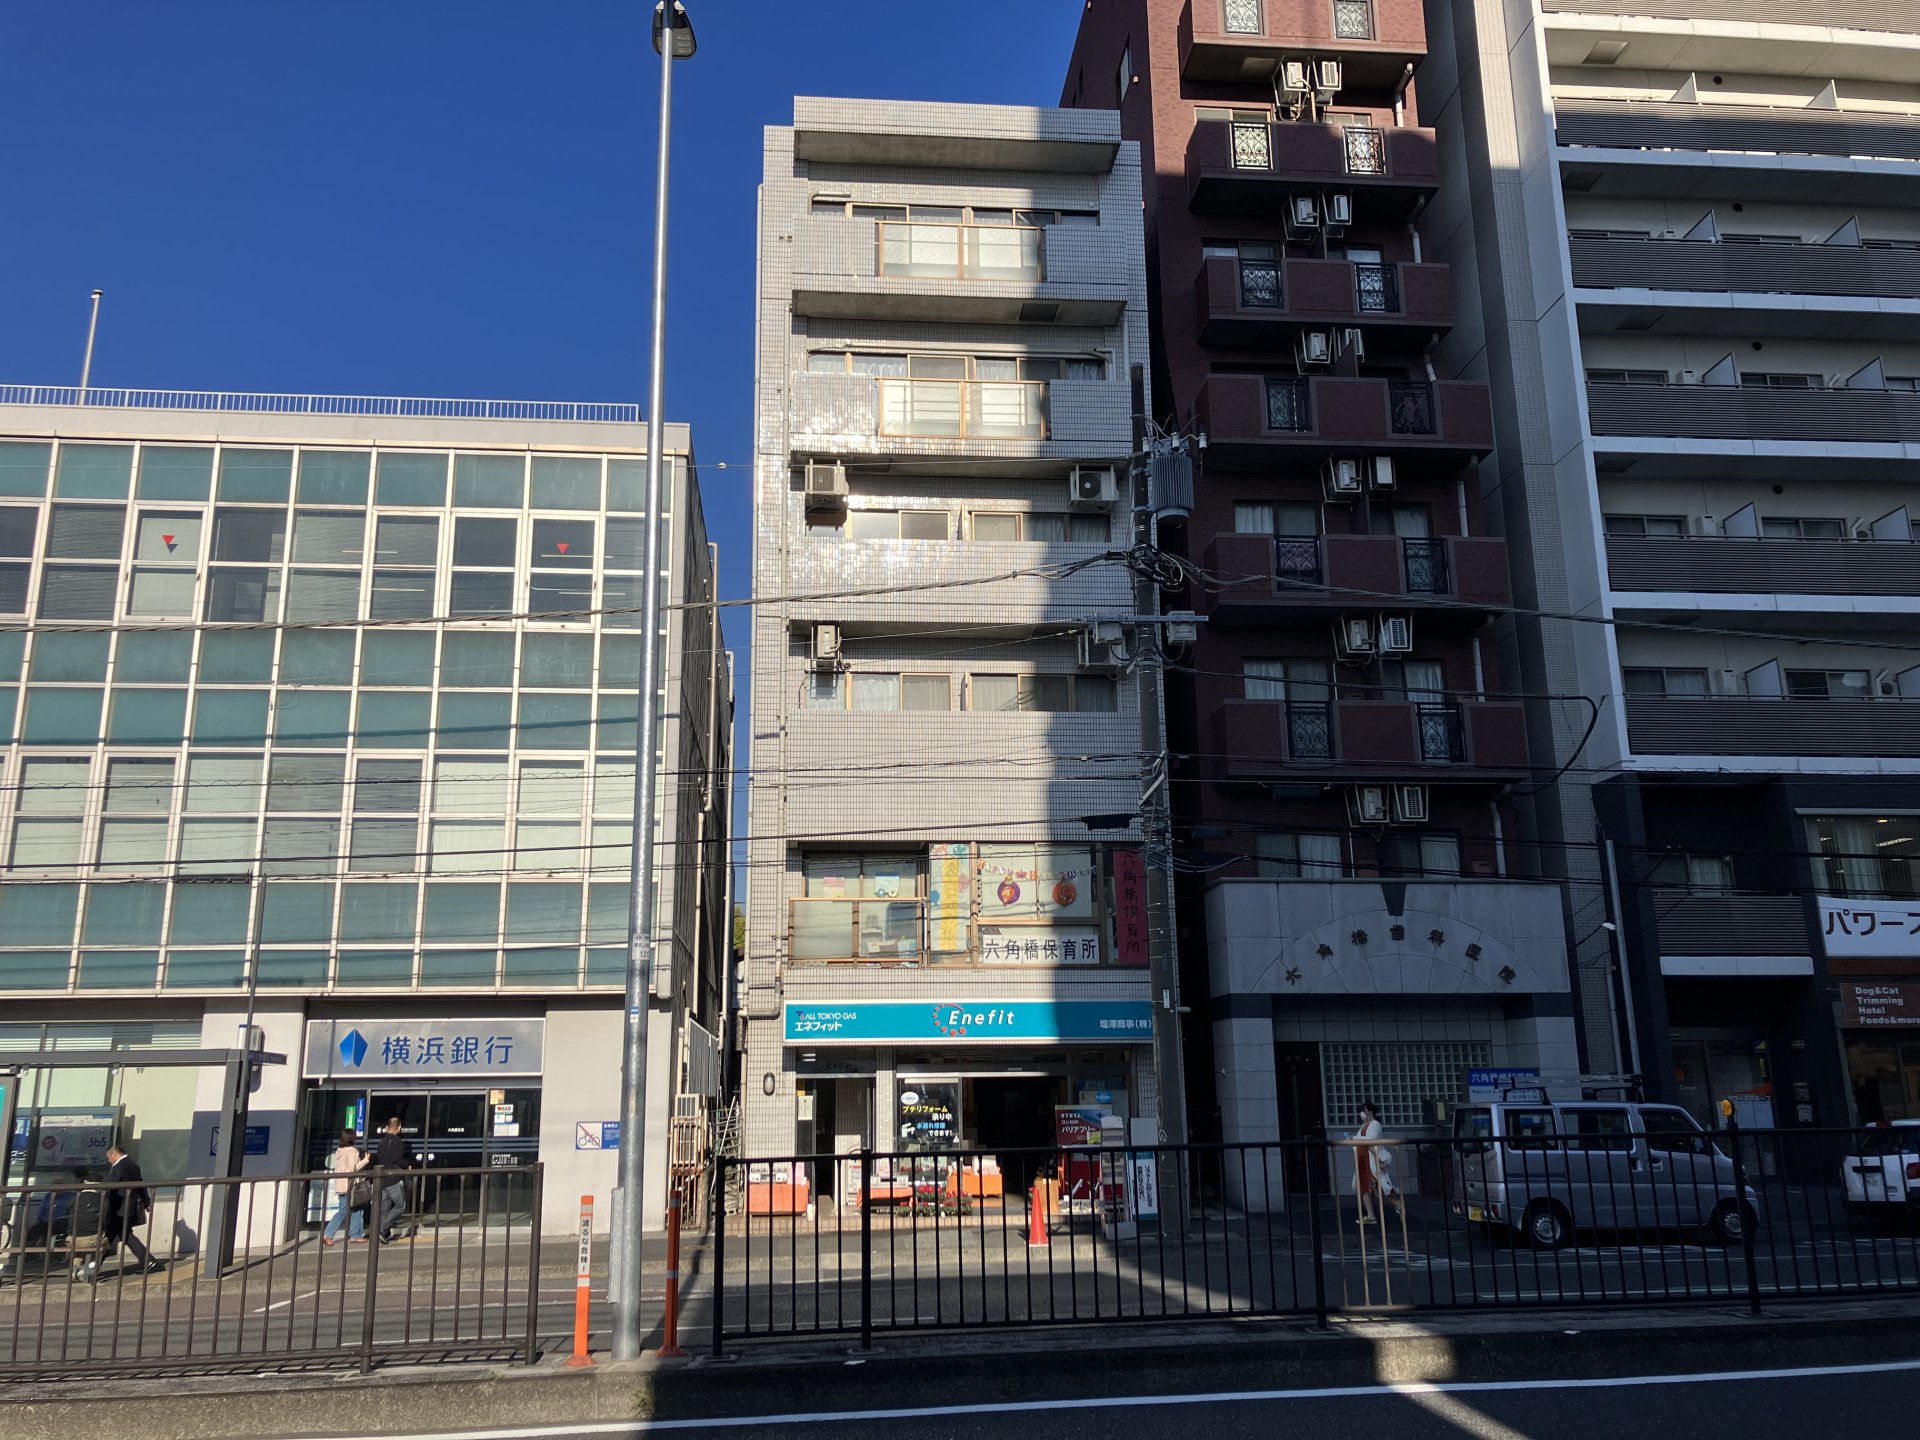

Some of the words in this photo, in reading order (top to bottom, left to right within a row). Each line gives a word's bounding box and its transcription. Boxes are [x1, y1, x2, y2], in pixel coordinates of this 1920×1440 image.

[1122, 853, 1140, 954] 六角橋保育所
[984, 939, 1097, 959] 六角橋保育所
[1855, 987, 1899, 996] Dog&Cat
[1856, 996, 1904, 1006] Trimming
[1858, 1006, 1886, 1014] Hotel
[805, 1012, 816, 1020] ALL
[818, 1012, 841, 1020] TOKYO
[948, 1010, 1015, 1025] Enefit
[1860, 1016, 1920, 1025] Foods&more
[795, 1021, 842, 1031] エネフィット
[382, 1036, 514, 1065] 横浜銀行
[903, 1105, 948, 1113] プチリフォーム
[932, 1113, 953, 1121] 承り中
[580, 1219, 590, 1272] 渡るな危険!
